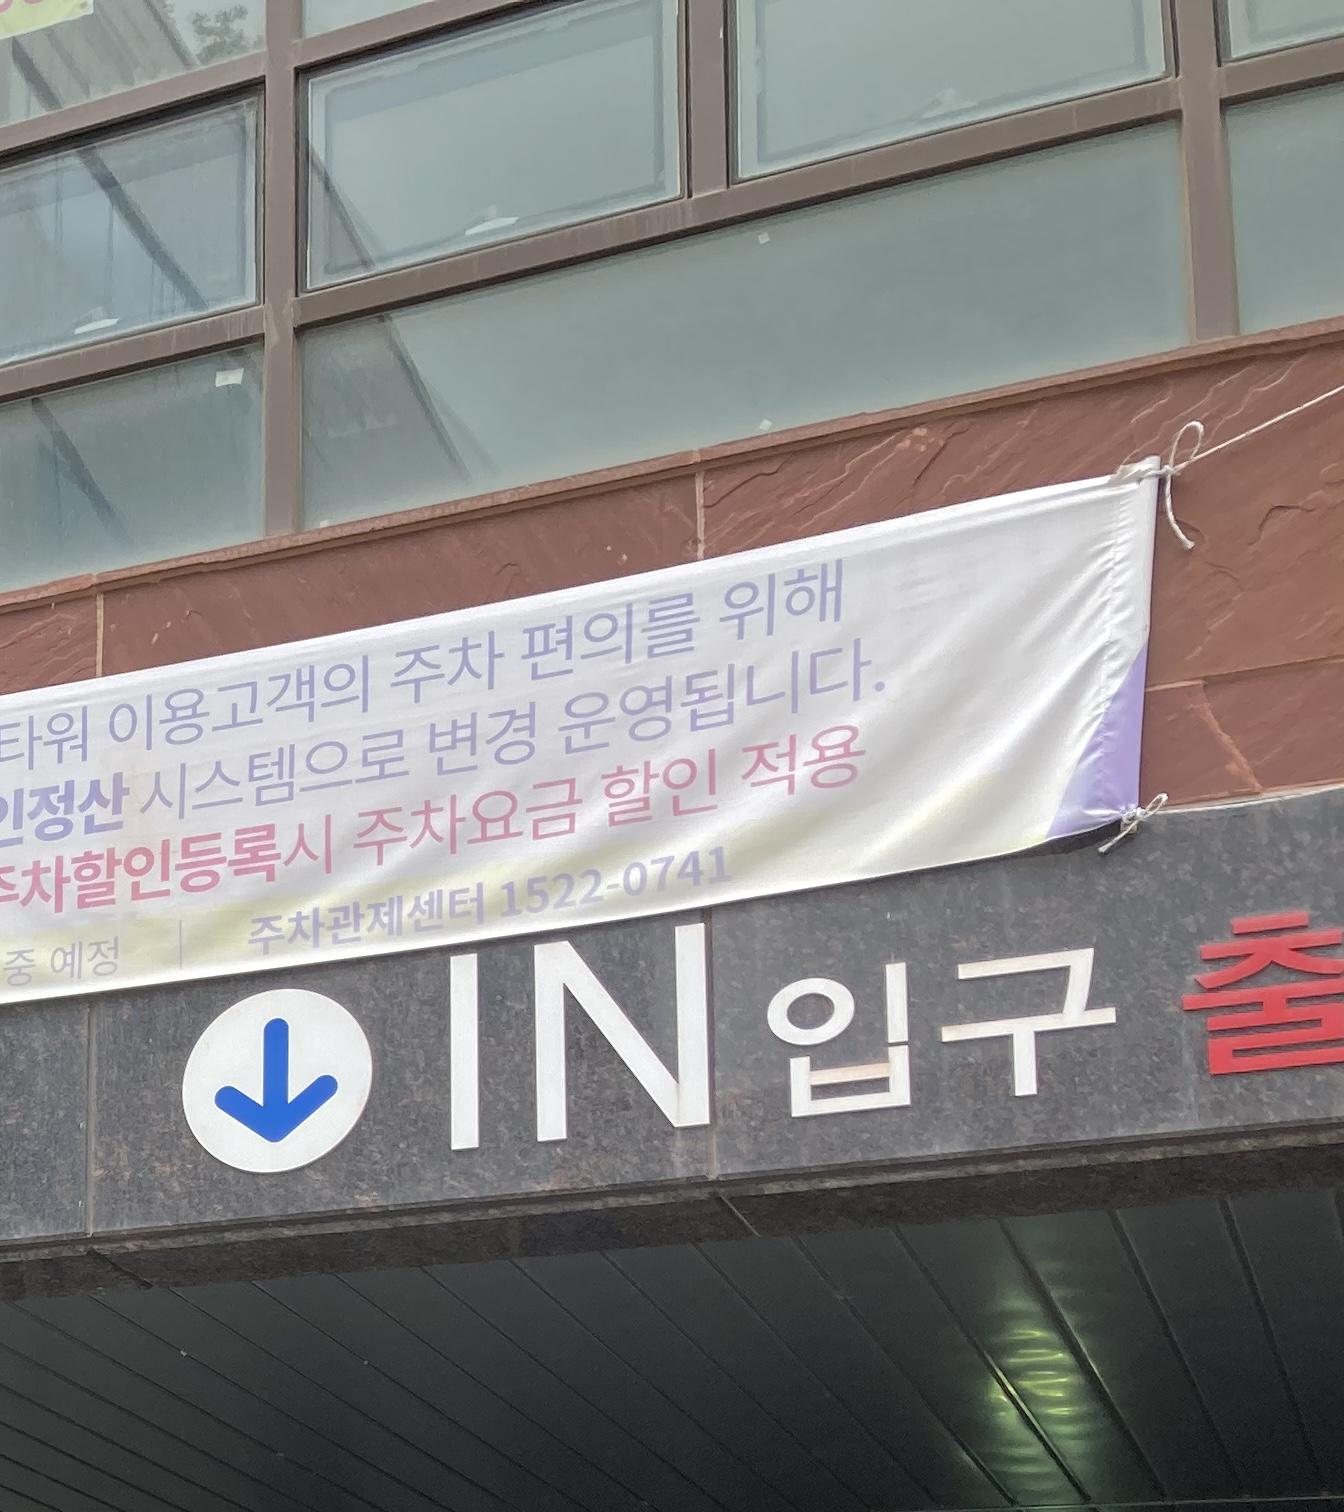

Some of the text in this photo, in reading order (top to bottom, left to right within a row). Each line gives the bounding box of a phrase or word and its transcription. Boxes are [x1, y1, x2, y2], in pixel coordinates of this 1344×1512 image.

[108, 656, 370, 751] 이용고객의
[390, 630, 505, 705] 주차
[520, 592, 700, 682] 편의를
[720, 559, 844, 642] 위해
[140, 729, 410, 820] 시스템으로
[428, 702, 537, 776] 변경
[557, 638, 887, 756] 운영됩니다.
[352, 777, 584, 868] 주차요금
[601, 748, 719, 828] 할인
[741, 723, 867, 798] 적용
[2, 947, 38, 988] 중
[49, 935, 121, 980] 예정
[246, 845, 732, 957] 주차관제센터 1522-0741
[449, 922, 712, 1151] IN
[766, 947, 1117, 1119] 입구
